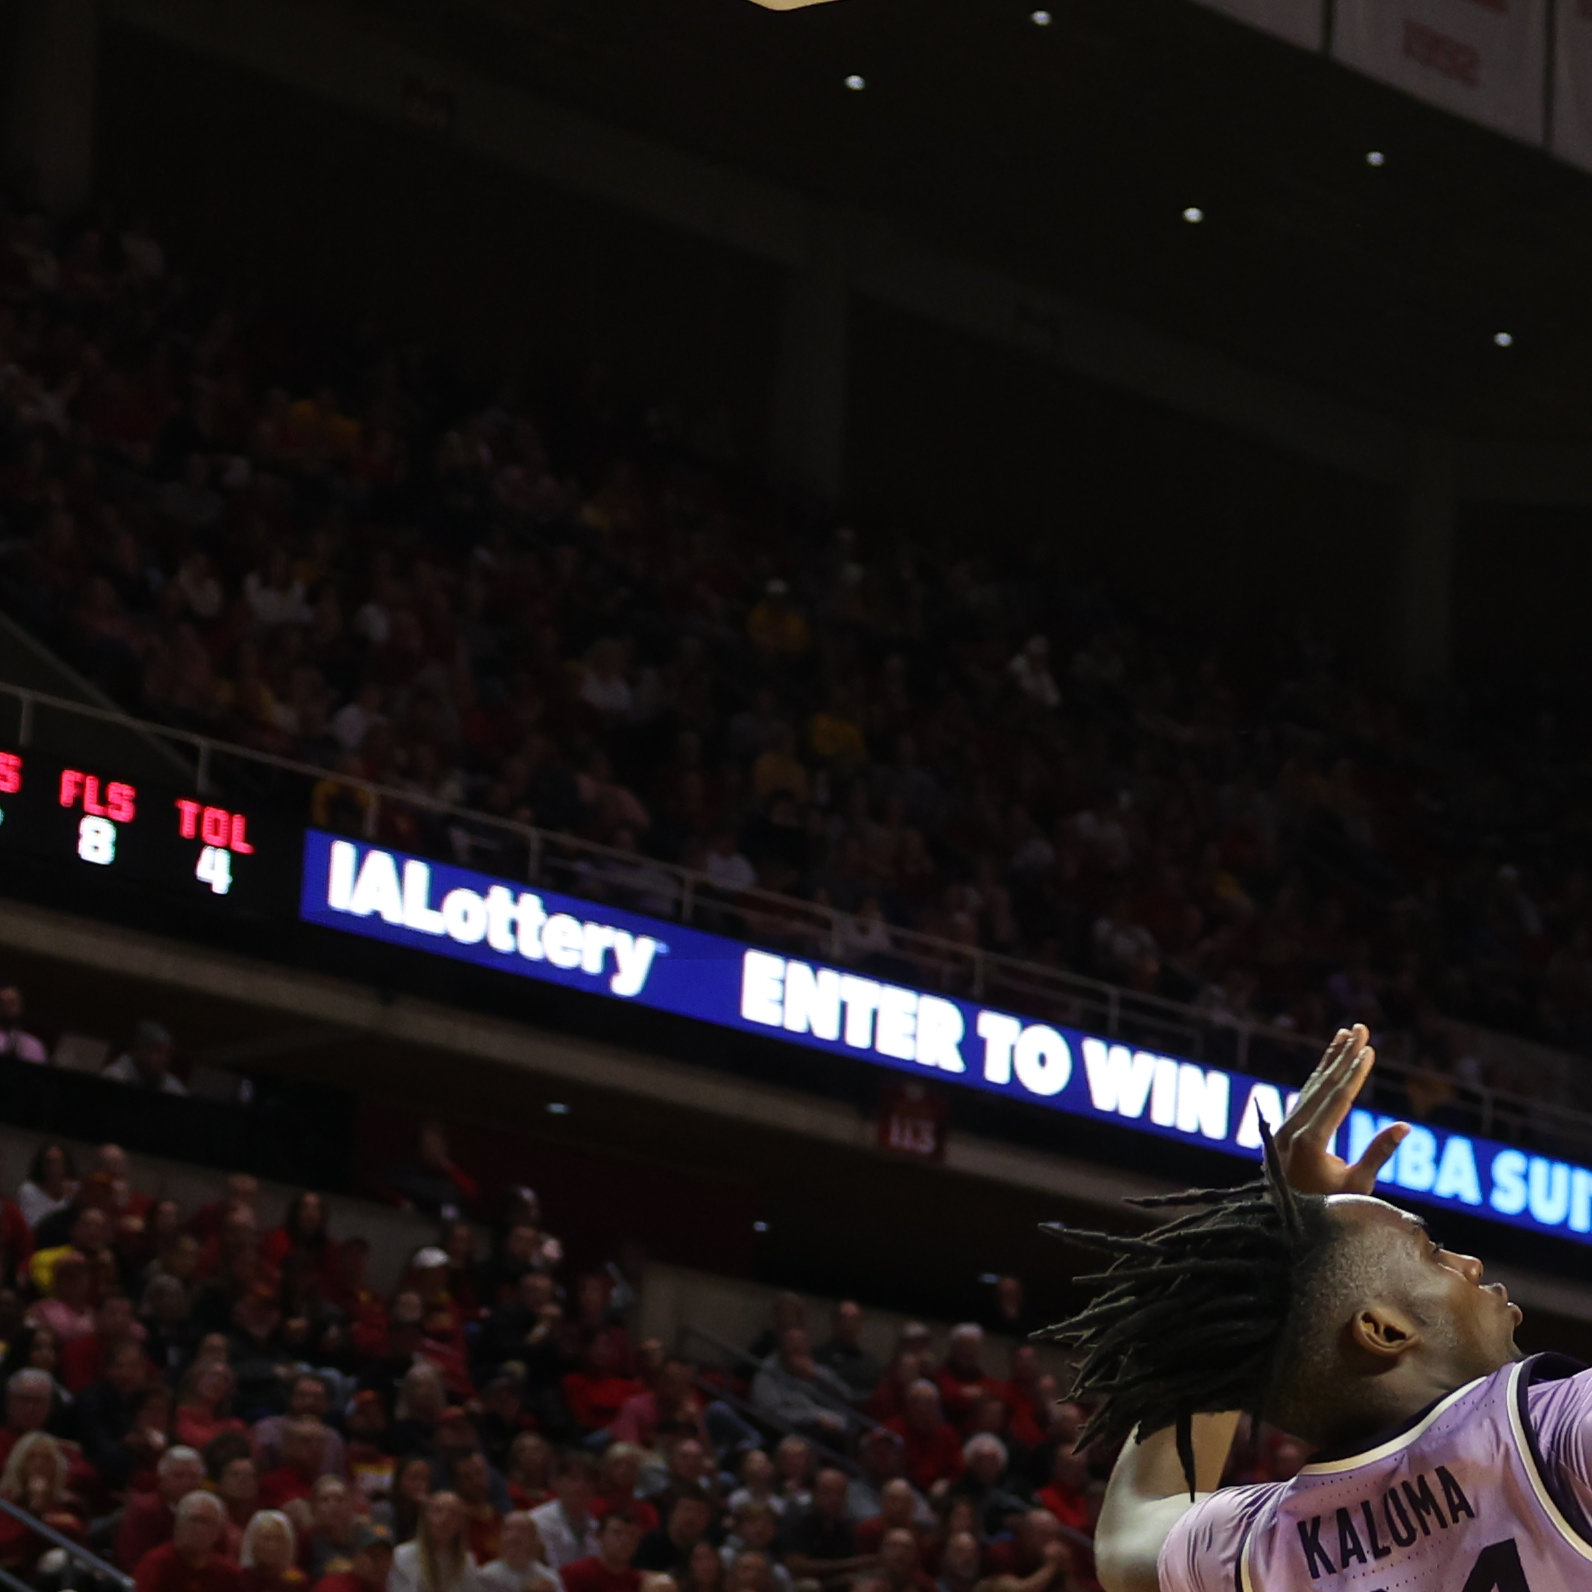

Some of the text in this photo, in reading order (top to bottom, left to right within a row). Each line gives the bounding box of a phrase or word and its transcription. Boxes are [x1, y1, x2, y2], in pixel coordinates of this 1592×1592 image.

[60, 769, 137, 823] FLS
[77, 815, 117, 866] 8
[195, 845, 233, 895] 4
[328, 841, 658, 998] IALottery
[741, 949, 966, 1072] ENTER
[977, 1010, 1072, 1097] TO
[1084, 1046, 1230, 1140] WIN
[1297, 1464, 1475, 1580] KALUMA
